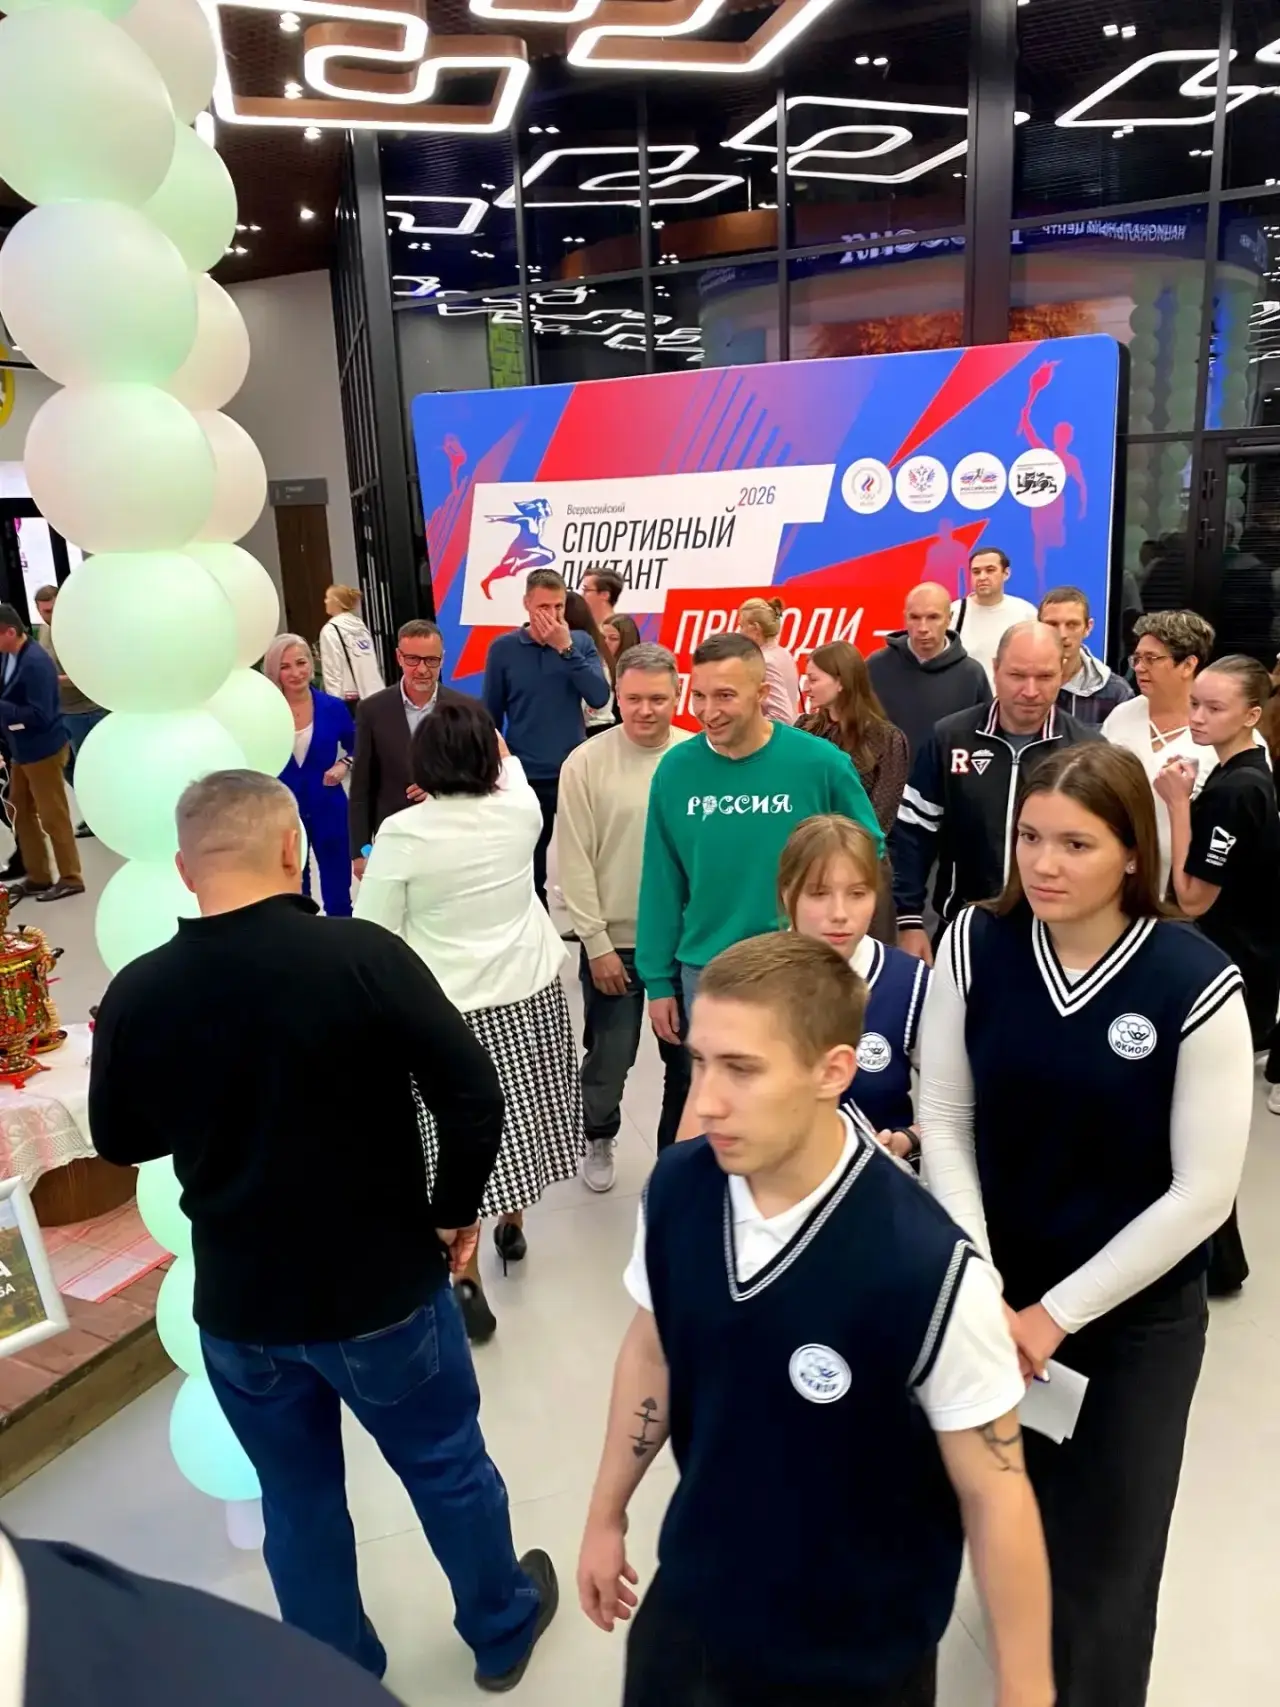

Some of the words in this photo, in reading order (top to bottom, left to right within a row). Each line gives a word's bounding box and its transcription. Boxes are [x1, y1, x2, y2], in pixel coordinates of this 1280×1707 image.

[738, 485, 776, 507] 2026
[566, 502, 626, 516] Всероссийский
[562, 505, 737, 553] СПОРТИВНЫЙ
[951, 748, 969, 773] R
[686, 793, 793, 821] РОССИЯ
